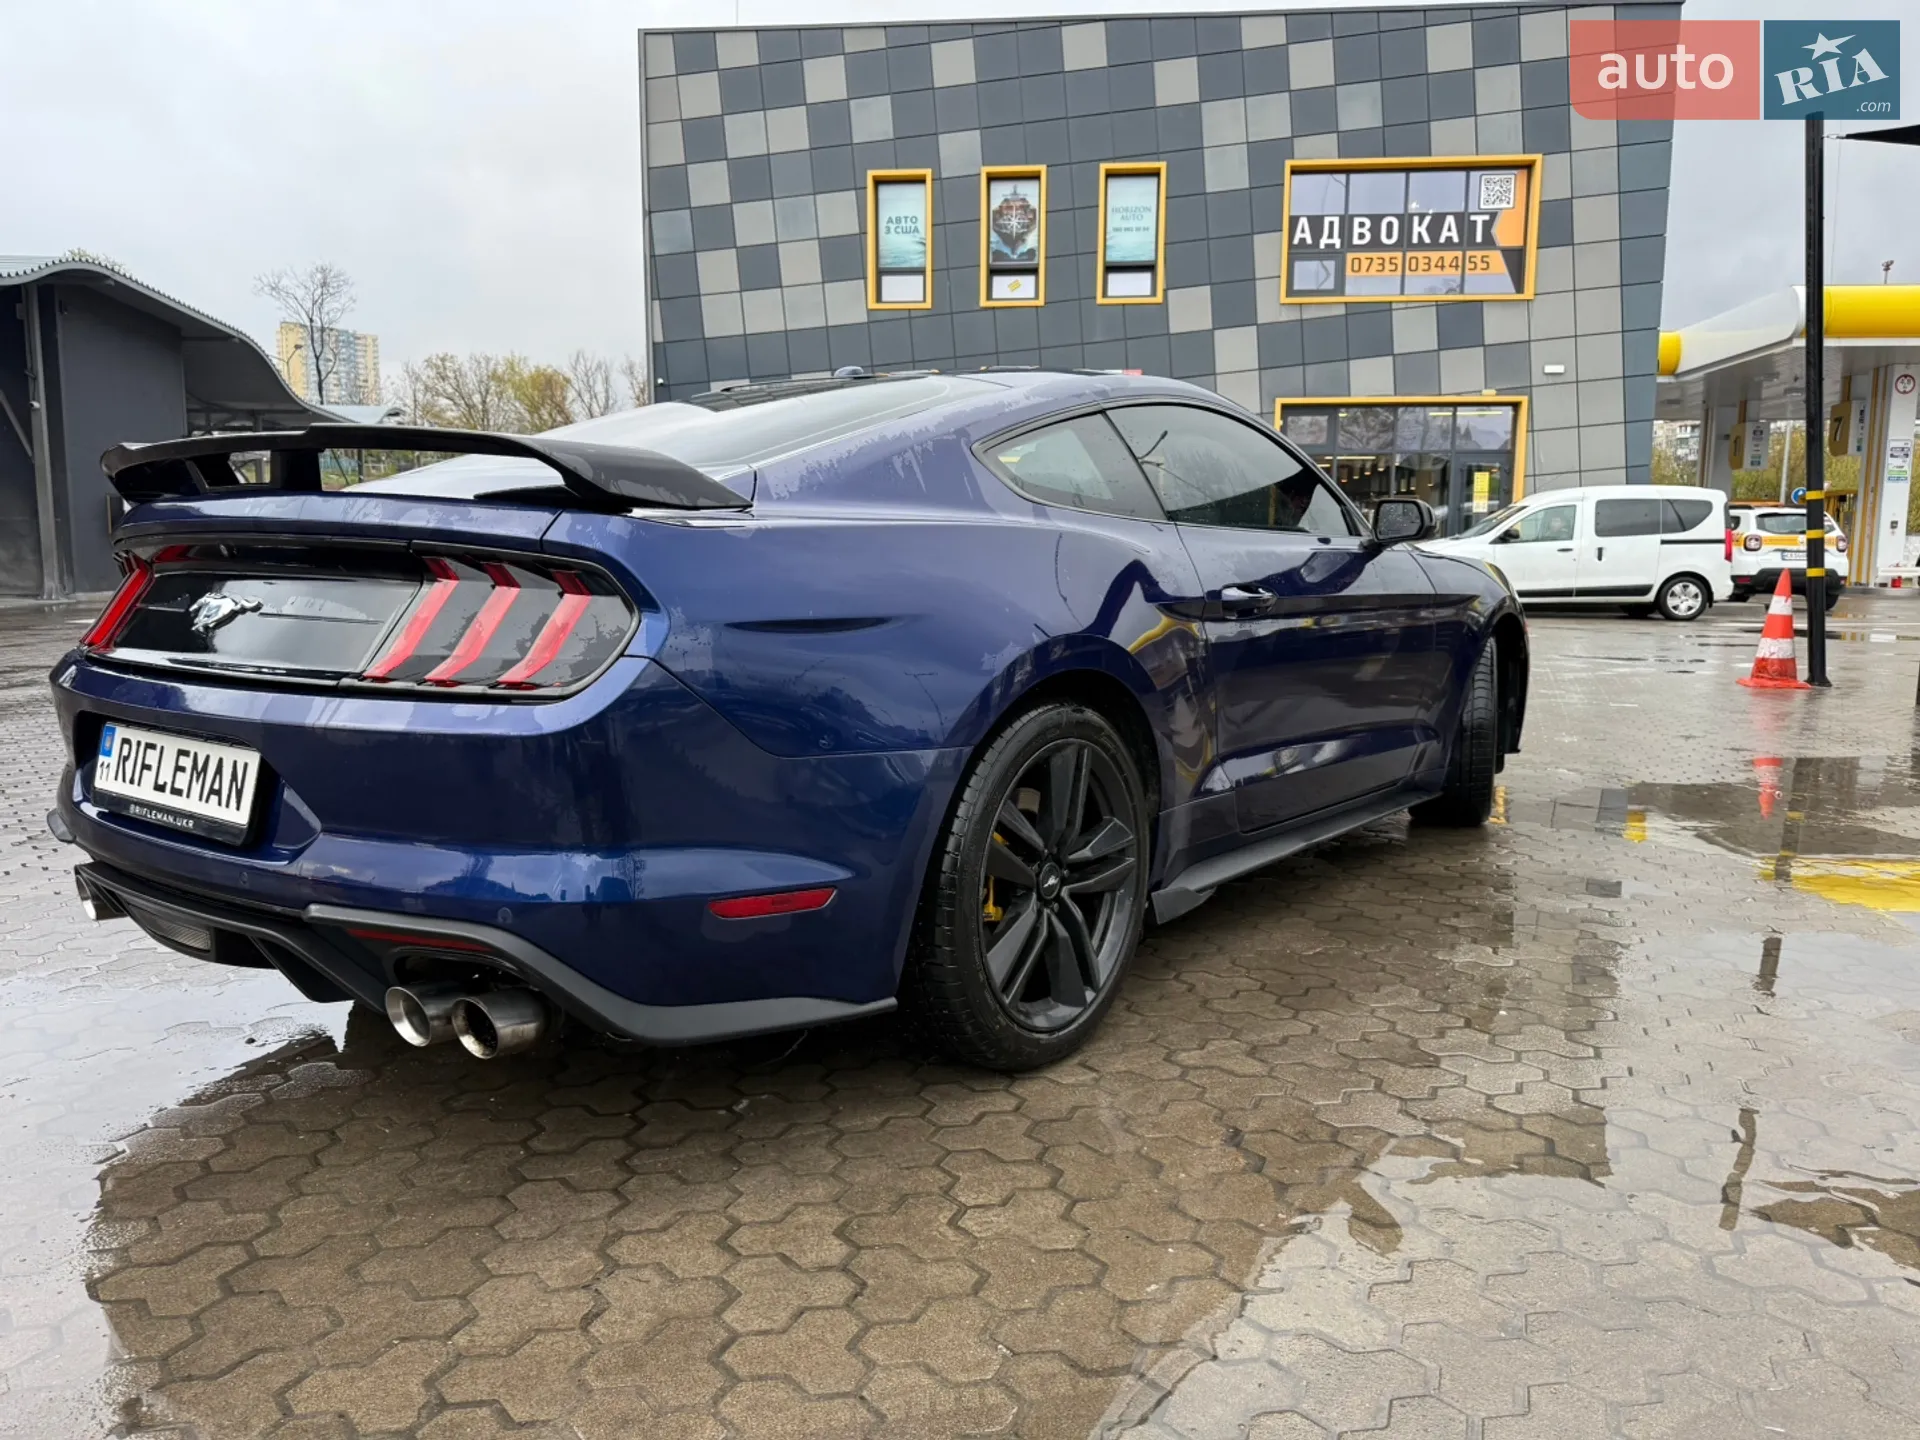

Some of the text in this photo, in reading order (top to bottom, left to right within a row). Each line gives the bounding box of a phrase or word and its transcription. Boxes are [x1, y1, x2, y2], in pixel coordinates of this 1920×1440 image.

[1111, 205, 1152, 214] HORIZON
[885, 215, 919, 225] АВТО
[1120, 213, 1144, 221] AUTO
[894, 225, 920, 235] США
[1292, 215, 1490, 249] АДВОКАТ
[1350, 254, 1490, 273] 0735 0344 55
[1834, 416, 1843, 441] 7
[114, 737, 249, 811] RIFLEMAN
